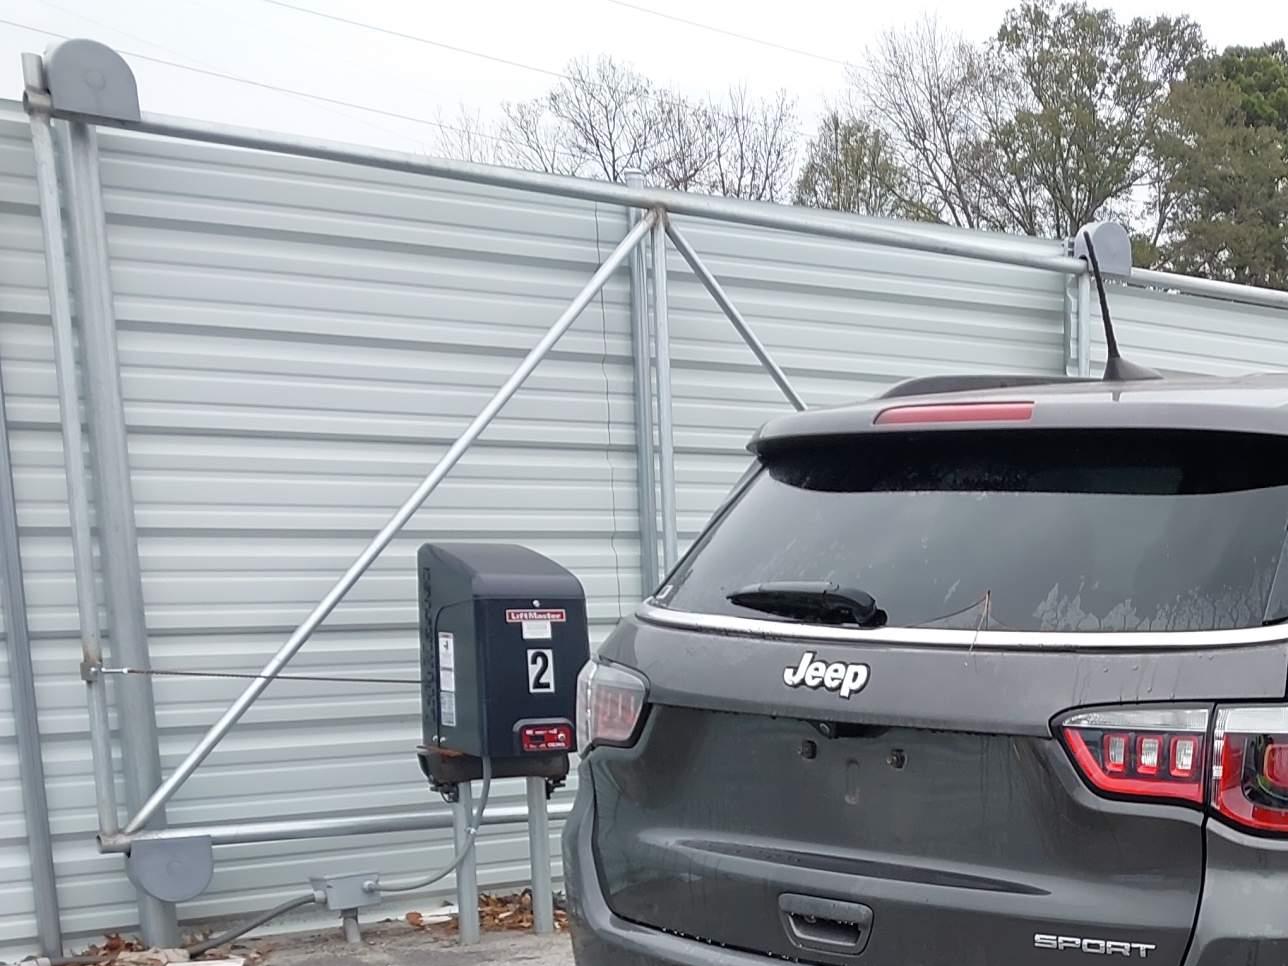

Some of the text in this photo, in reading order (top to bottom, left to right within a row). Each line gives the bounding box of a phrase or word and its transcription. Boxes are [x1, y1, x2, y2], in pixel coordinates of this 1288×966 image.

[511, 611, 562, 620] LiftMaster
[530, 651, 551, 690] 2
[783, 651, 870, 699] Jeep
[1033, 933, 1156, 957] SPORT
